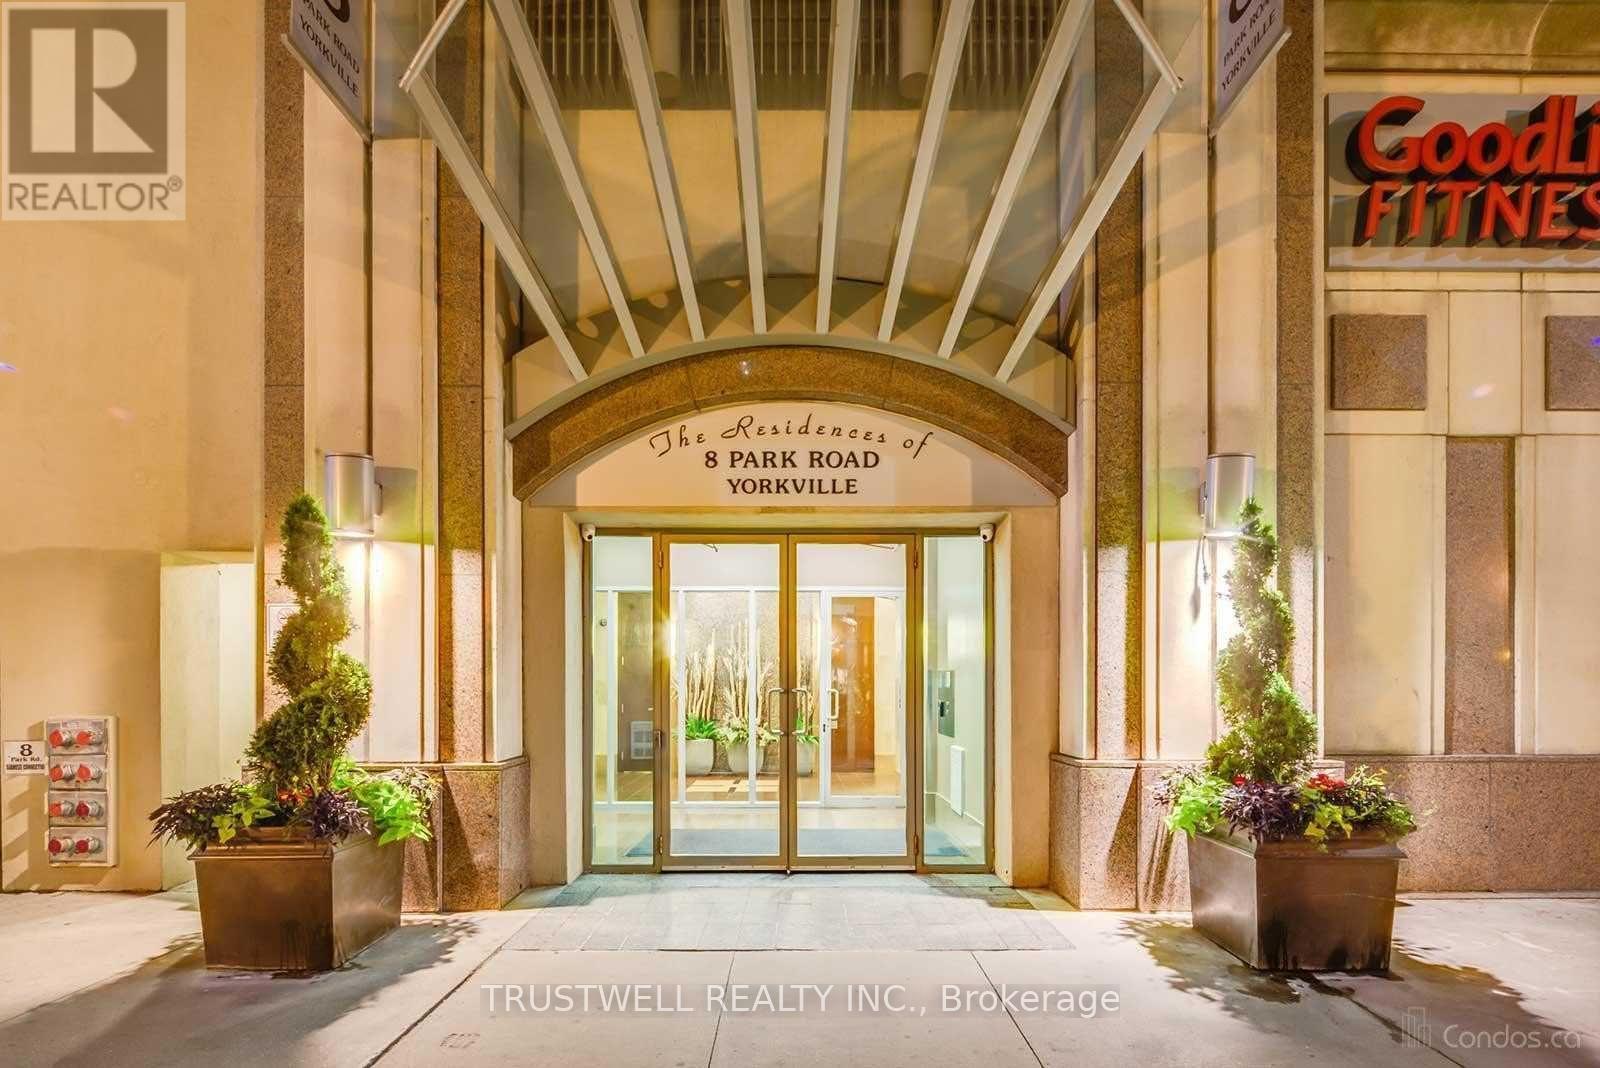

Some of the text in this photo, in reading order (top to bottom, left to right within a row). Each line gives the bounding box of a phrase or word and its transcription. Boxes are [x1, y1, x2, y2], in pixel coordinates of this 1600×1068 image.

[300, 14, 360, 98] YORKVILLE
[333, 33, 360, 74] ROAD
[1222, 8, 1278, 90] YORKVILLE
[1223, 25, 1247, 67] PARK
[649, 413, 935, 460] The Residences of
[704, 450, 880, 469] 8 PARK ROAD
[727, 478, 858, 495] YORKVILLE
[20, 743, 33, 757] 8
